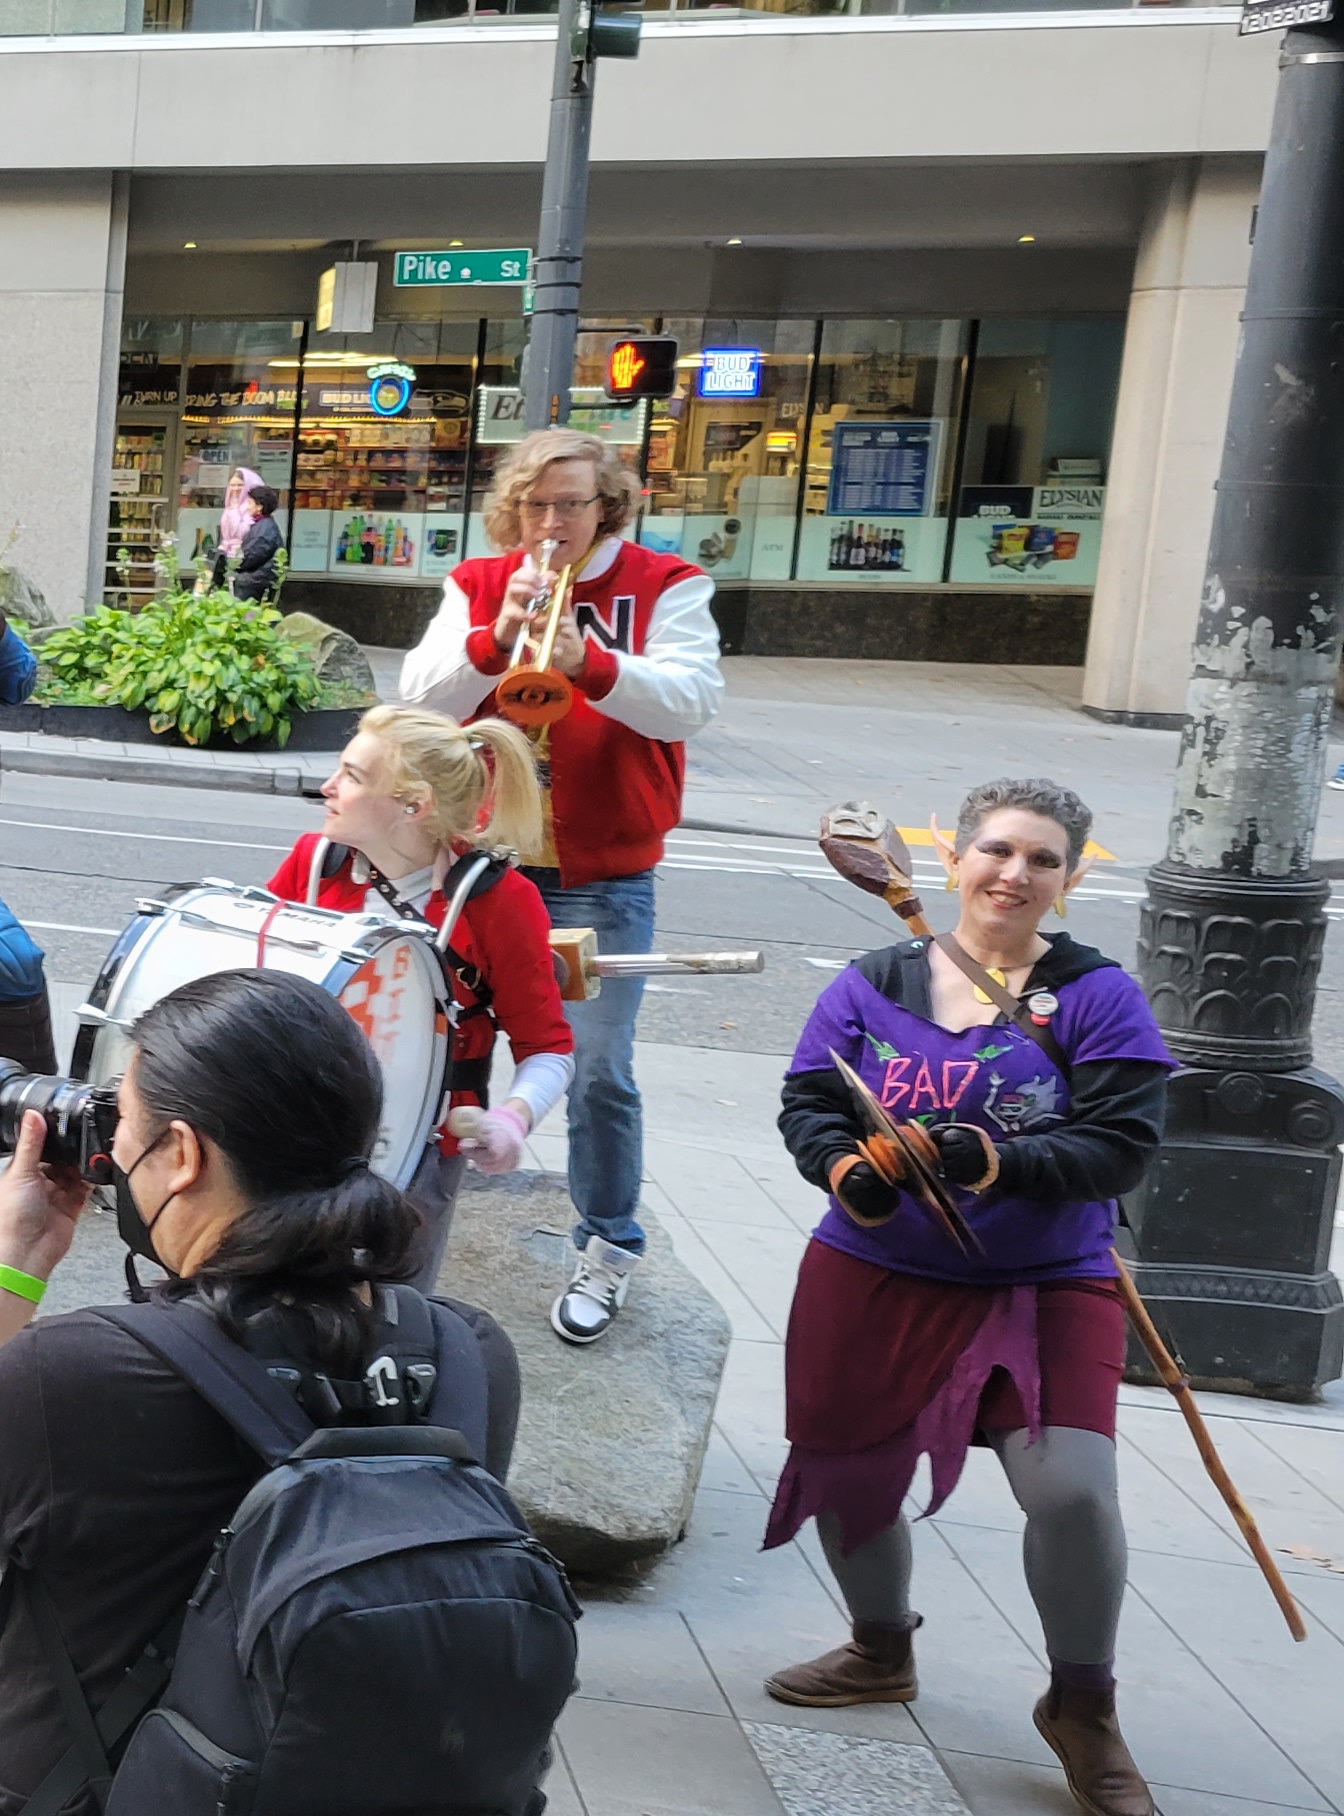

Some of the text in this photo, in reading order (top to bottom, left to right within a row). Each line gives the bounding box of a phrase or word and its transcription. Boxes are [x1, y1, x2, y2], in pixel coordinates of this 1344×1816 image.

[403, 255, 521, 280] Pike St
[714, 355, 751, 371] BUD
[706, 372, 755, 390] LIGHT
[203, 451, 229, 462] OPEN
[1040, 489, 1103, 508] ELYSIAN
[979, 505, 1012, 515] BUD
[575, 595, 636, 655] N
[880, 1055, 980, 1110] BAD
